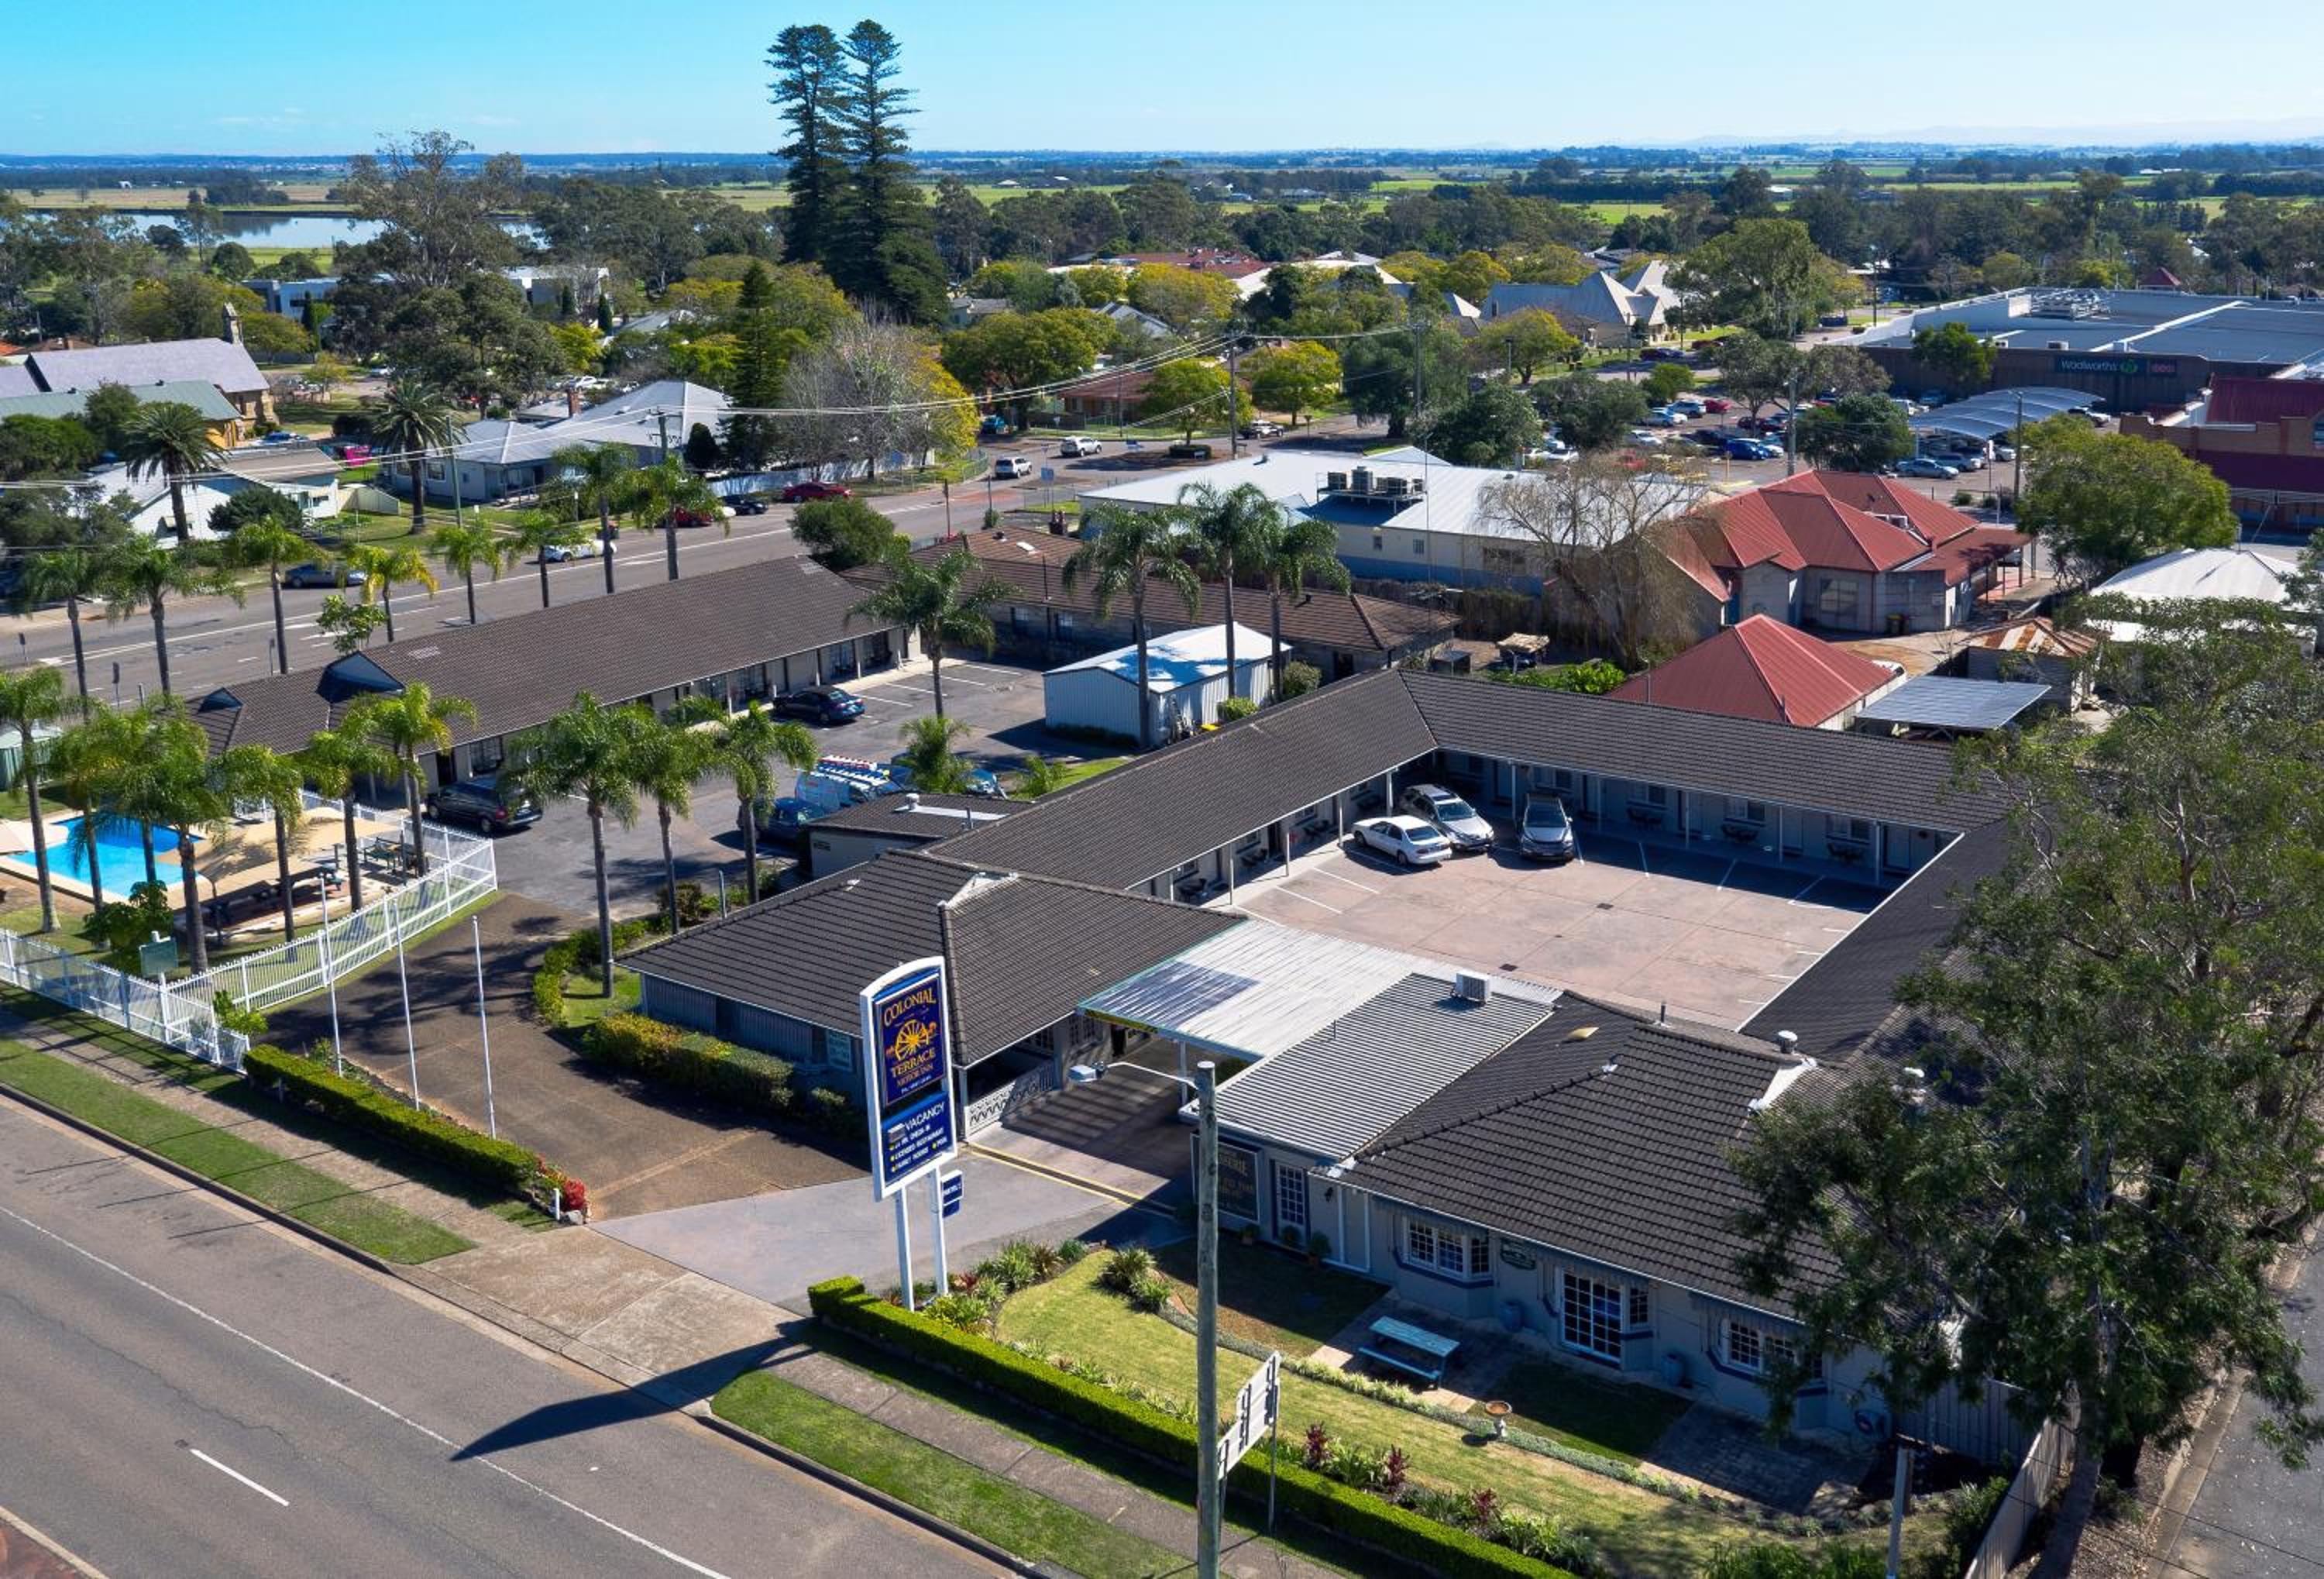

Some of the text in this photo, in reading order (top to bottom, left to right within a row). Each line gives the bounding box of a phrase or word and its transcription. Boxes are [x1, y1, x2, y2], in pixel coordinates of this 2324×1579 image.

[2061, 359, 2117, 371] Woolworths
[884, 987, 936, 1026] COLONIAL
[891, 1047, 935, 1078] TERRACE
[905, 1102, 944, 1131] VACANCY
